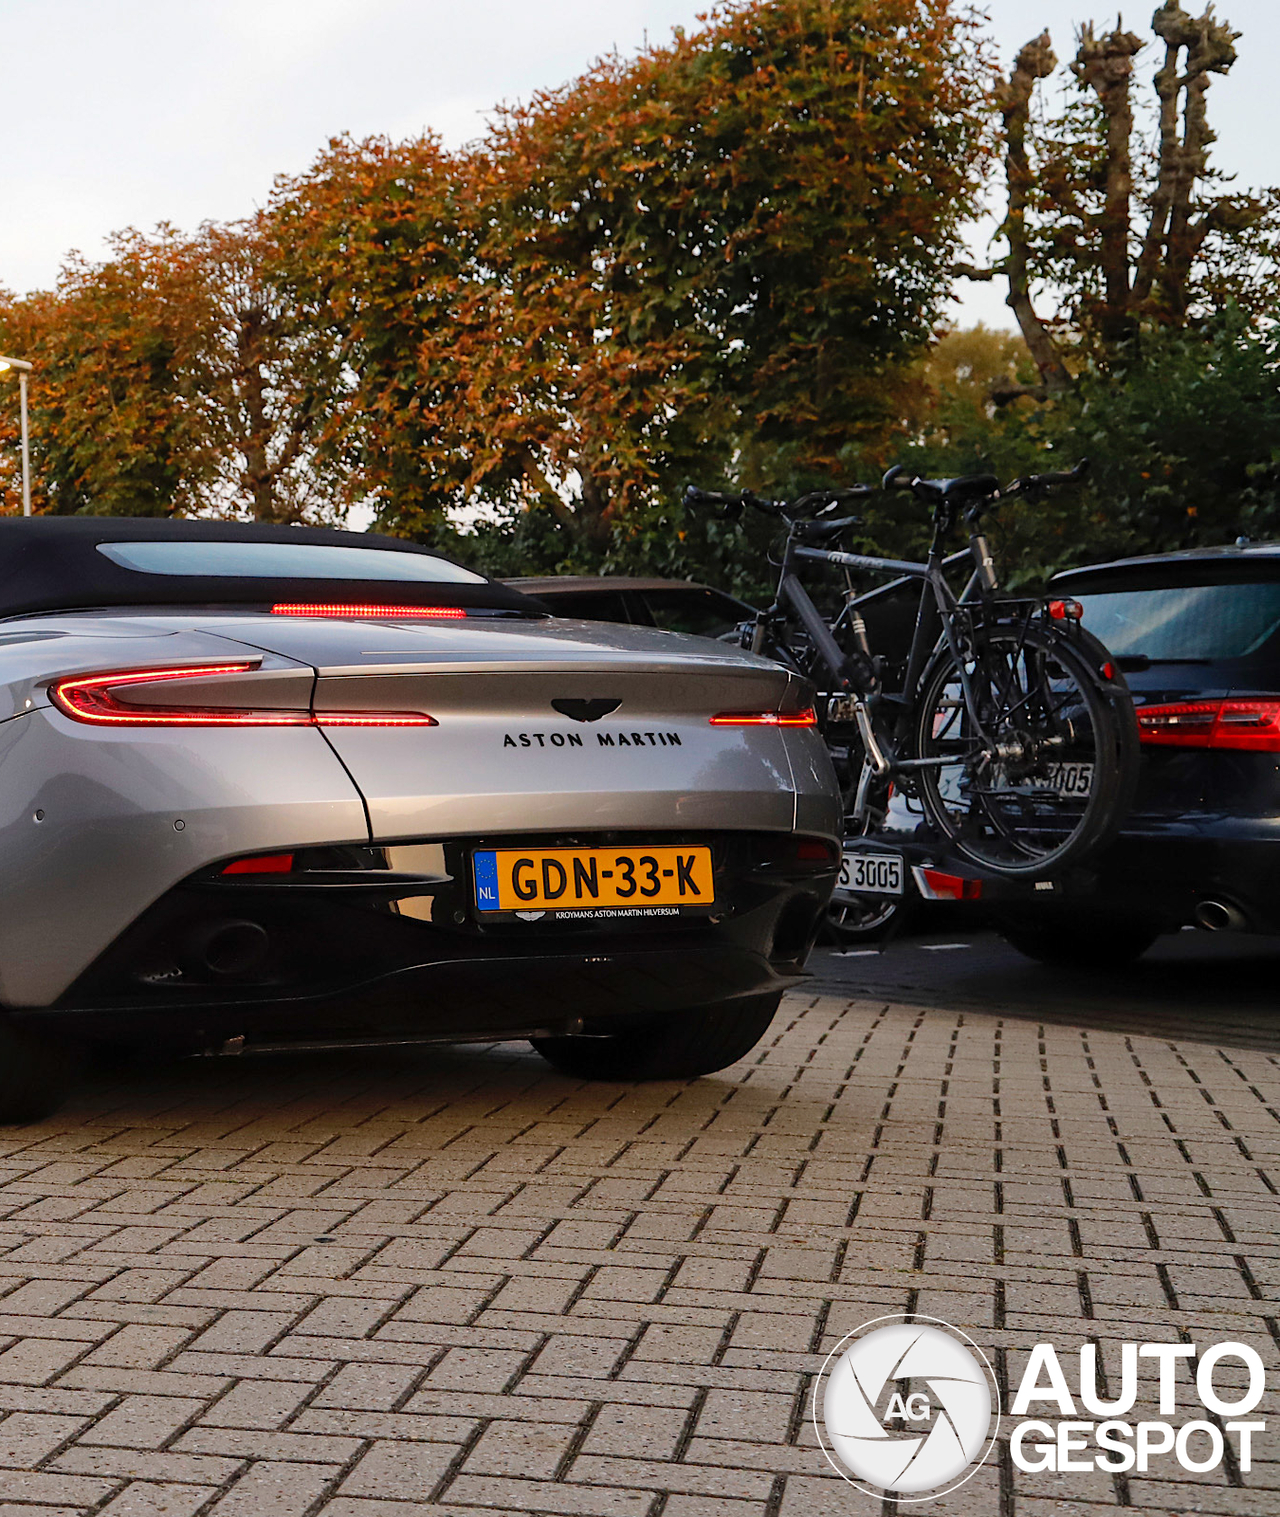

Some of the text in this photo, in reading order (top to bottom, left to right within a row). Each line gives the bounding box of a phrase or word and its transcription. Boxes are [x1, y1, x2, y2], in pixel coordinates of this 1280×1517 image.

[503, 732, 682, 747] ASTON MARTIN
[511, 855, 701, 901] GDN-33-K
[840, 858, 899, 888] S 3005
[479, 887, 496, 900] NL
[555, 907, 680, 920] KROYMANS ASTON MARTIN HILVERSUM
